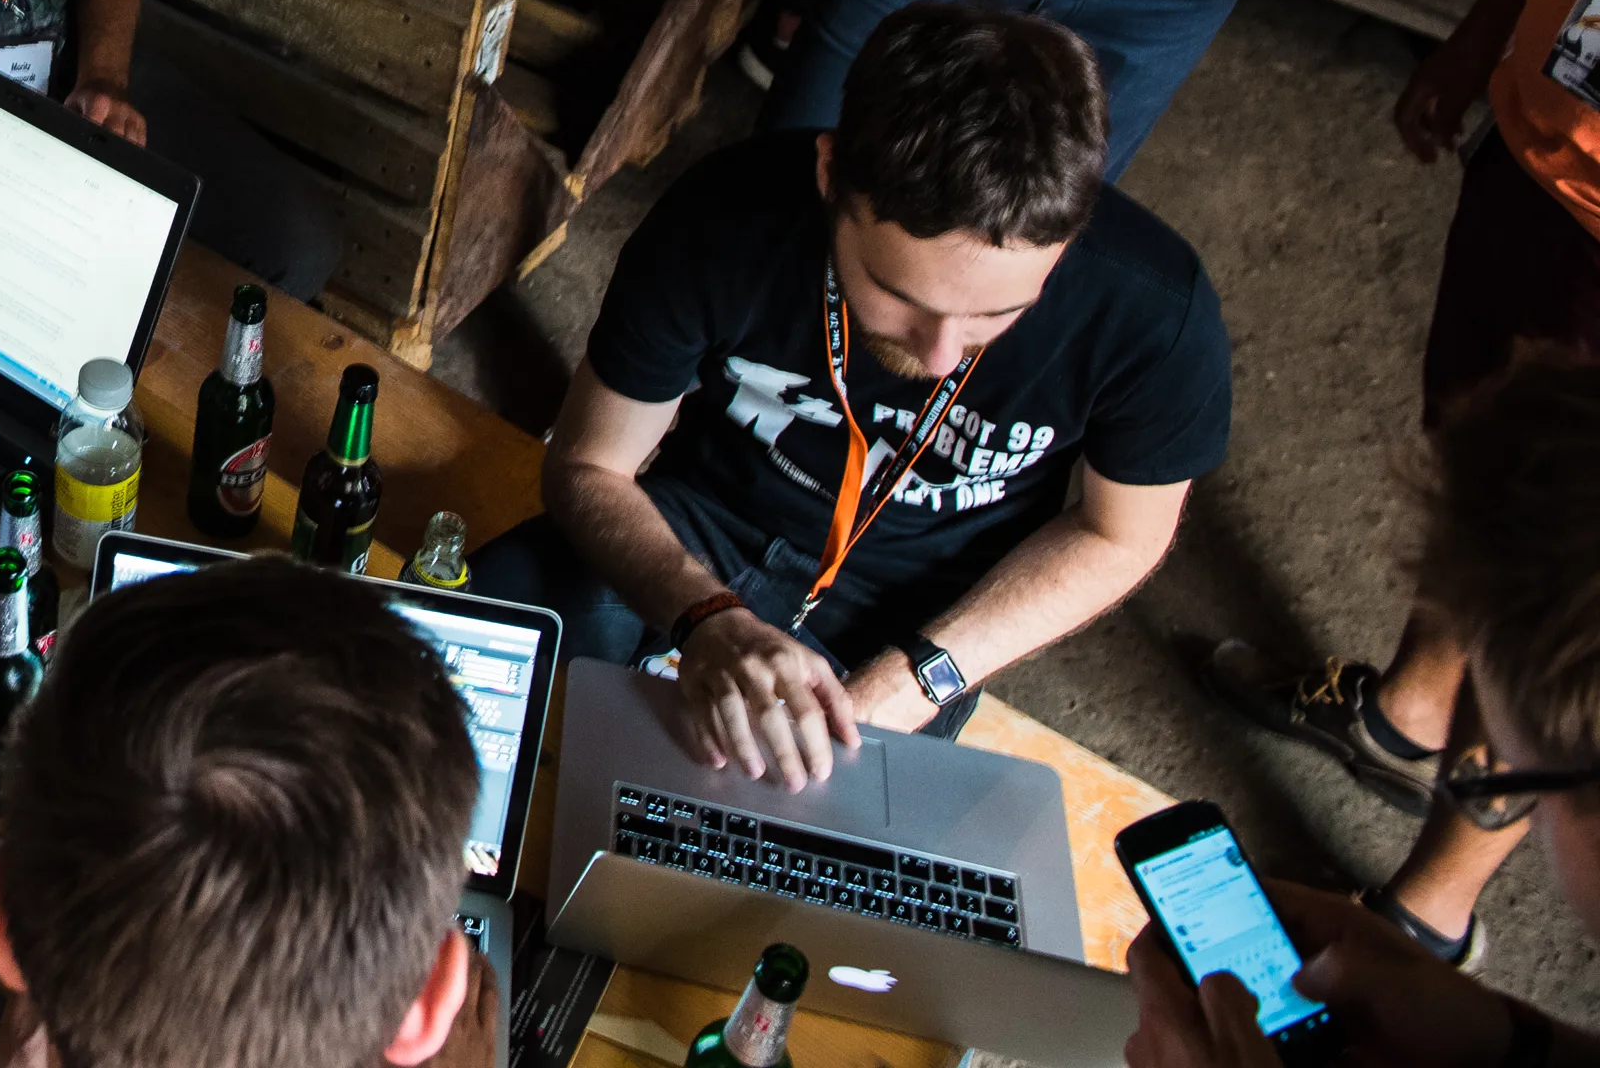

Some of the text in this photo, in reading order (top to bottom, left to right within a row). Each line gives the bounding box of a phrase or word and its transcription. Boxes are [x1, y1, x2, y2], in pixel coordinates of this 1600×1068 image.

[873, 402, 1045, 477] PRBLEMS
[949, 404, 1055, 454] GOT 99
